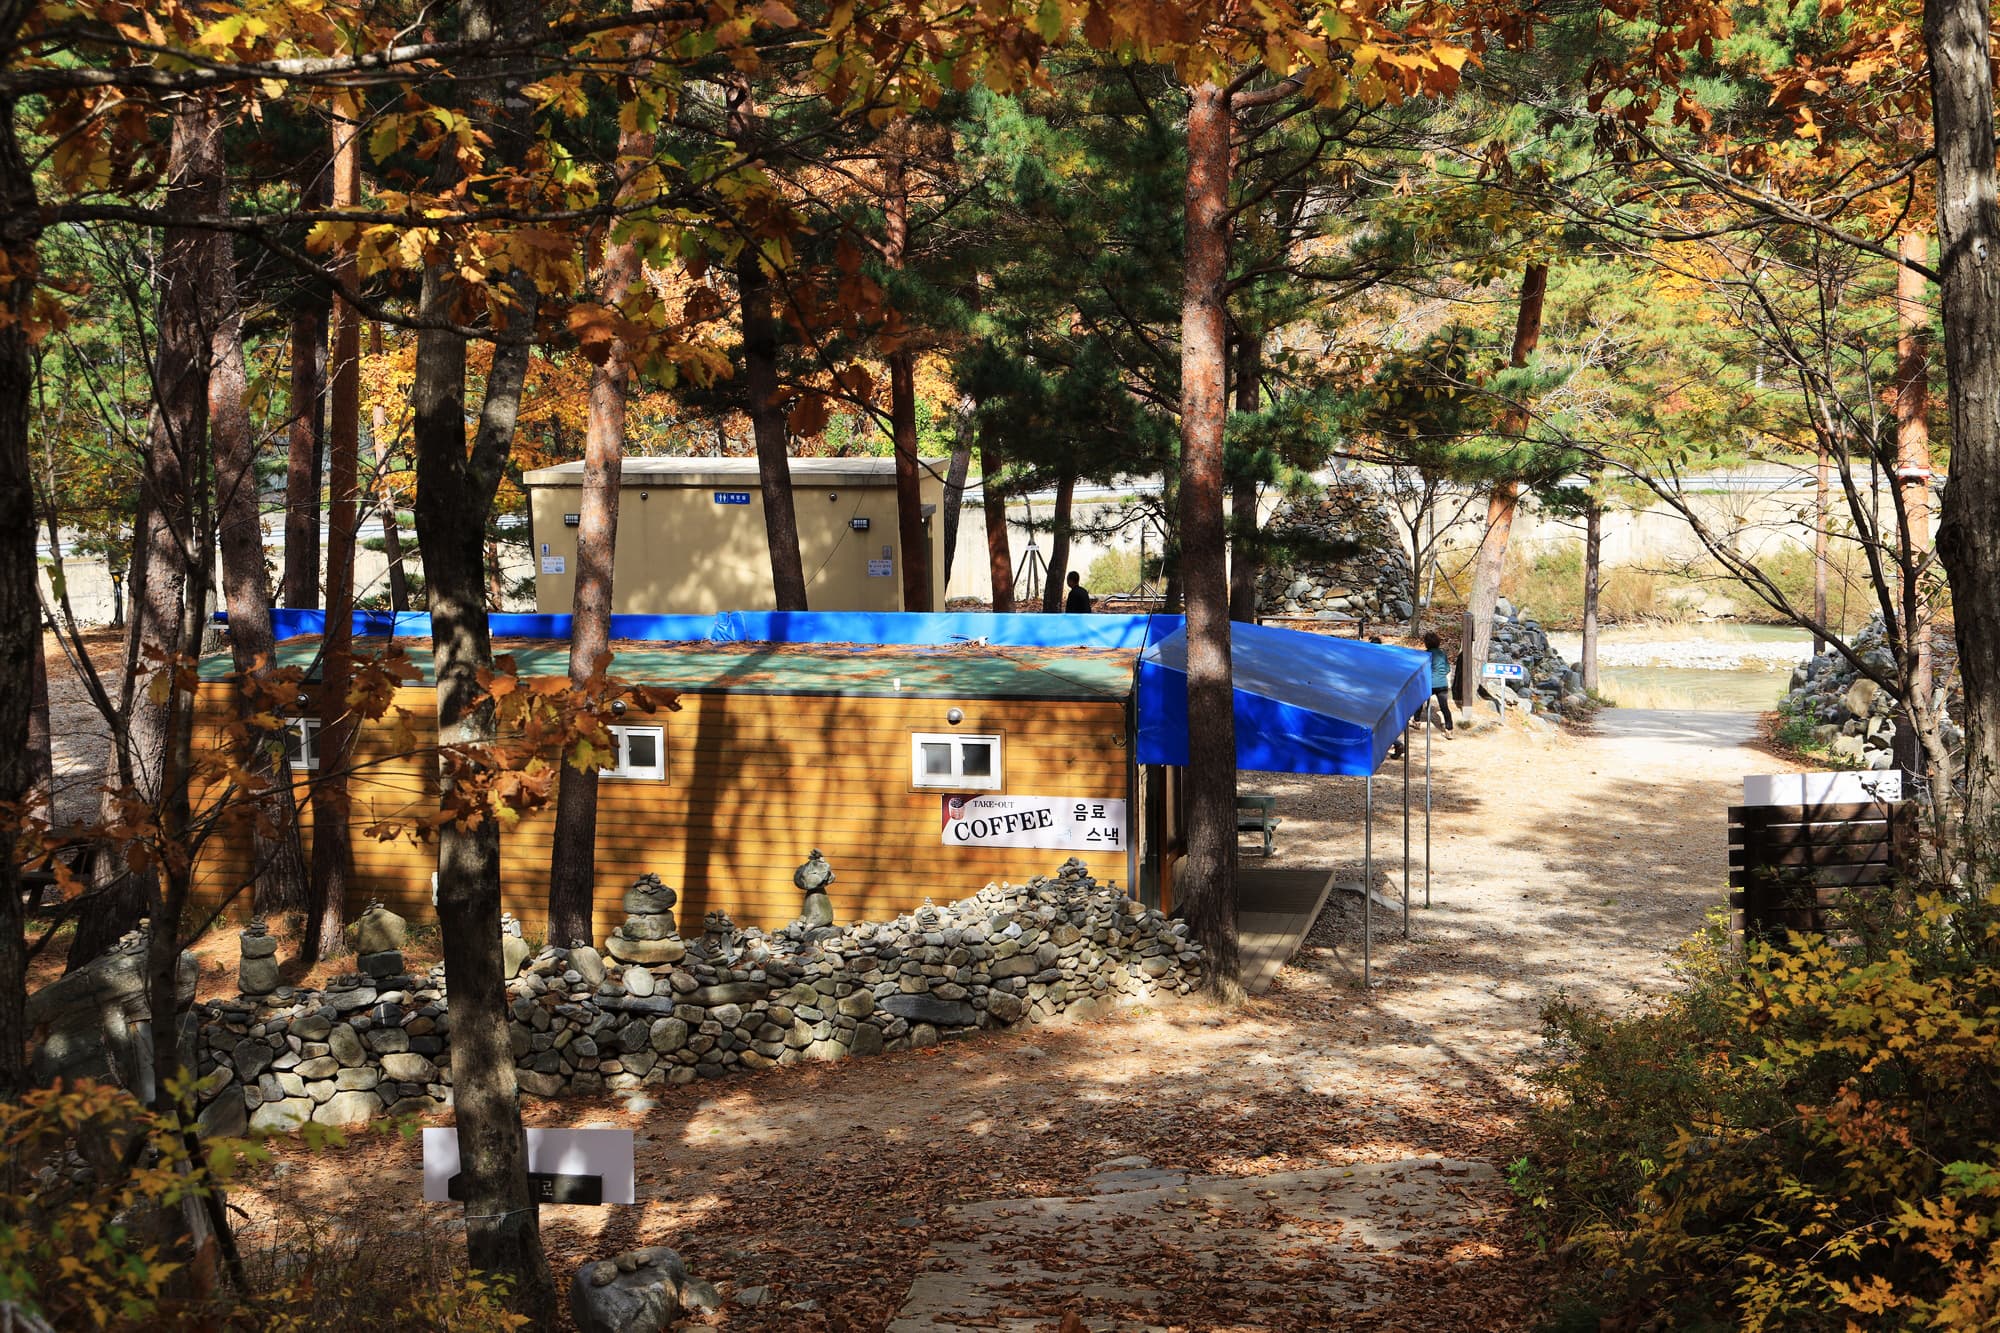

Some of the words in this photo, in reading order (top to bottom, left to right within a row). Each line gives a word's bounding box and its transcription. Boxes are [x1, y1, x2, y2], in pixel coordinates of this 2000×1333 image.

[972, 800, 1015, 809] TAKE-OUT
[1073, 803, 1106, 822] 음료
[954, 808, 1053, 841] COFFEE
[1086, 827, 1119, 845] 스낵
